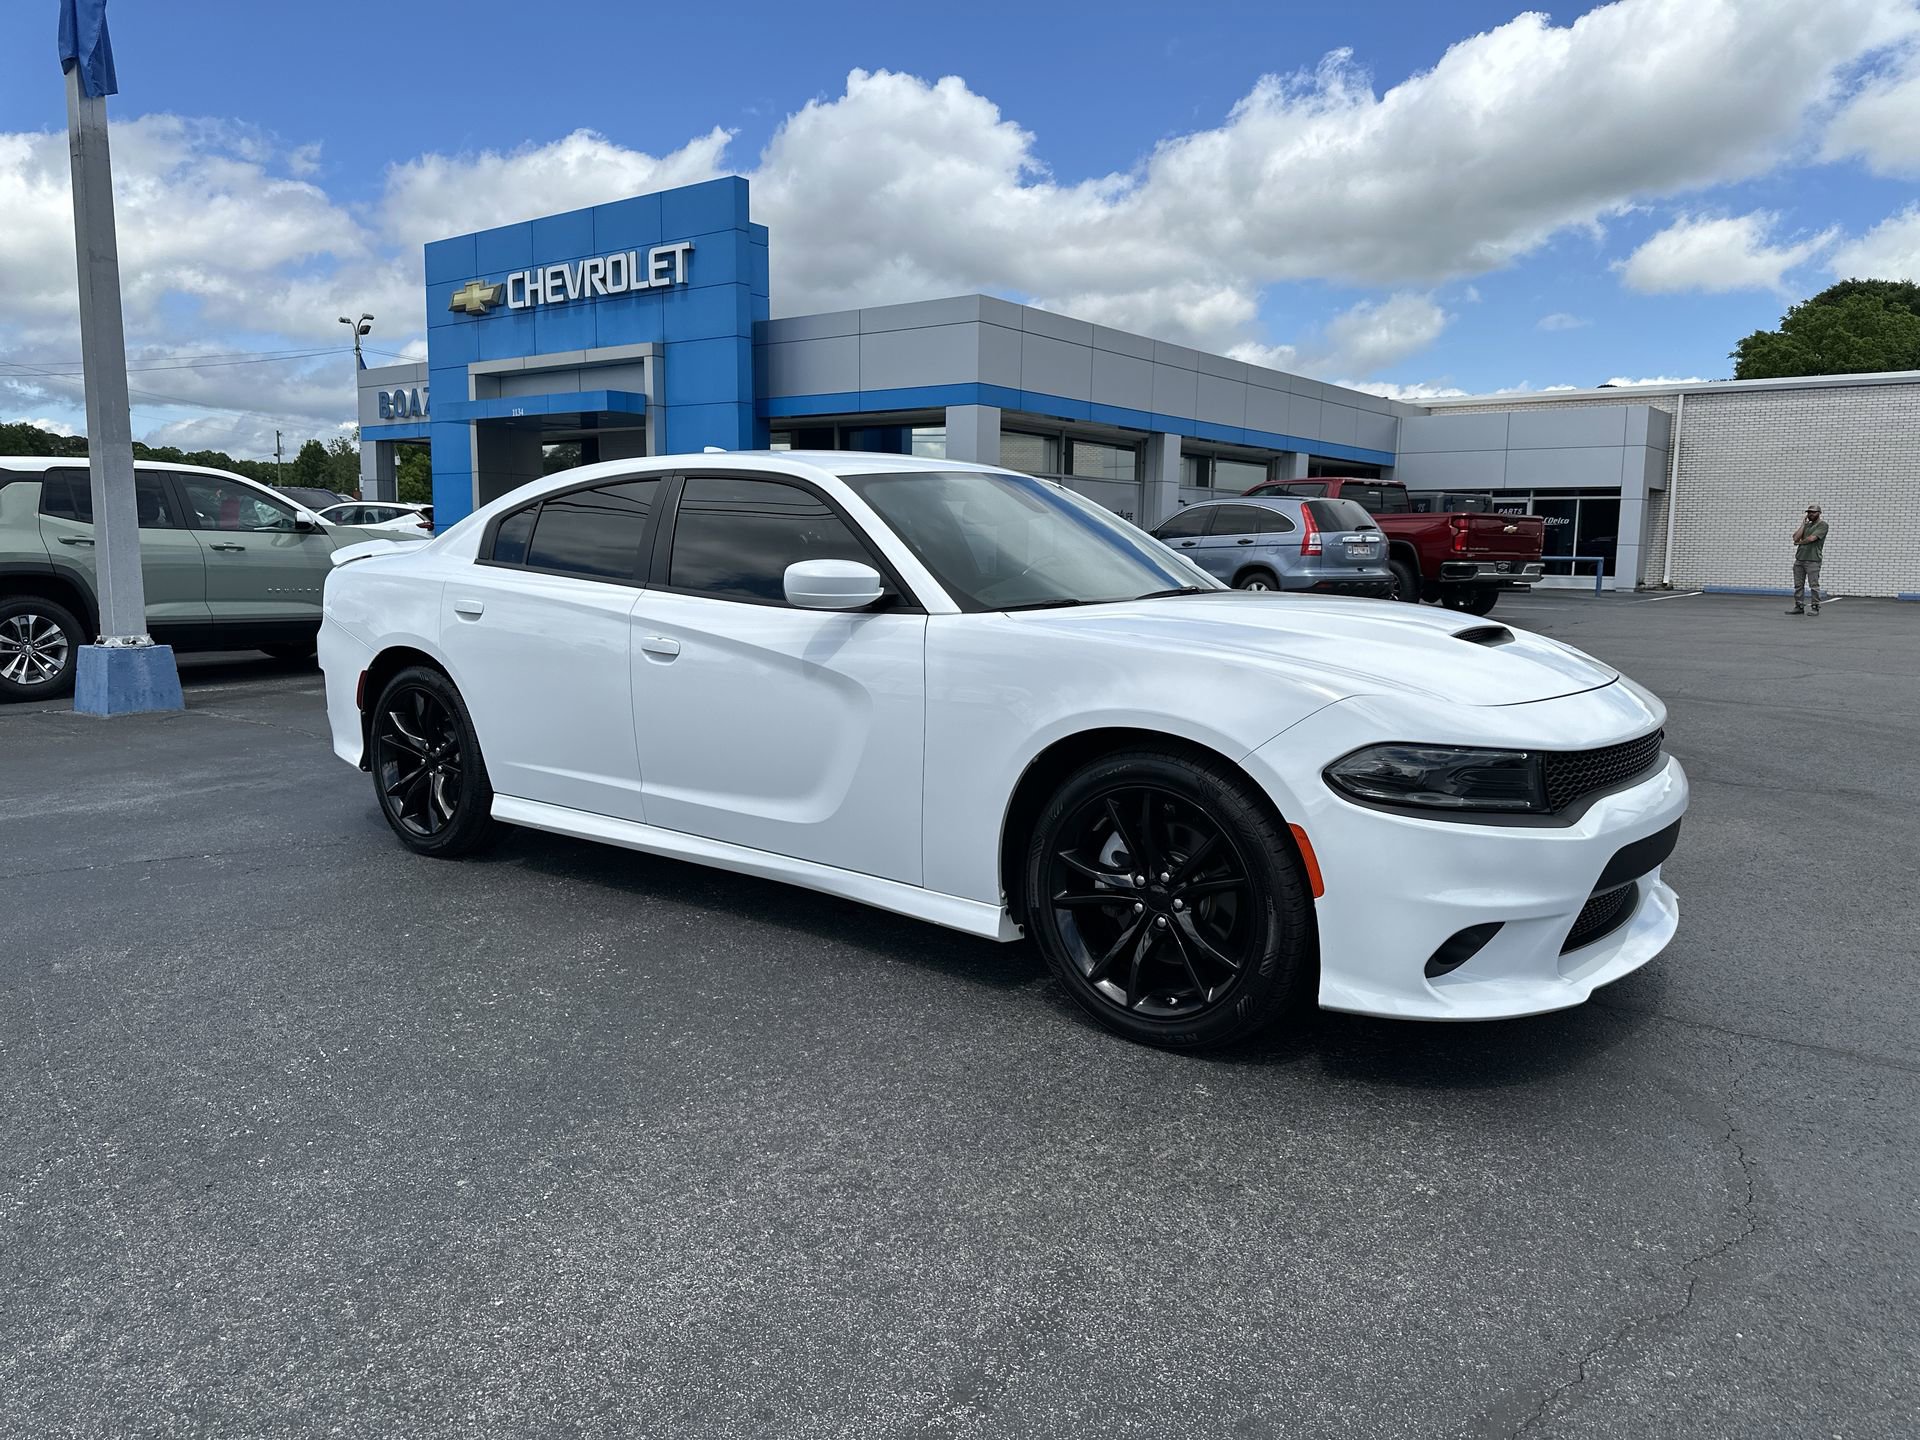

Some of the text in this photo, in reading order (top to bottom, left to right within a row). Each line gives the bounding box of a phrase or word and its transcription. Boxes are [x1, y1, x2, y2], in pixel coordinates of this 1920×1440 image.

[507, 241, 693, 310] CHEVROLET
[1497, 508, 1523, 516] PARTS
[1543, 516, 1570, 525] CDelco
